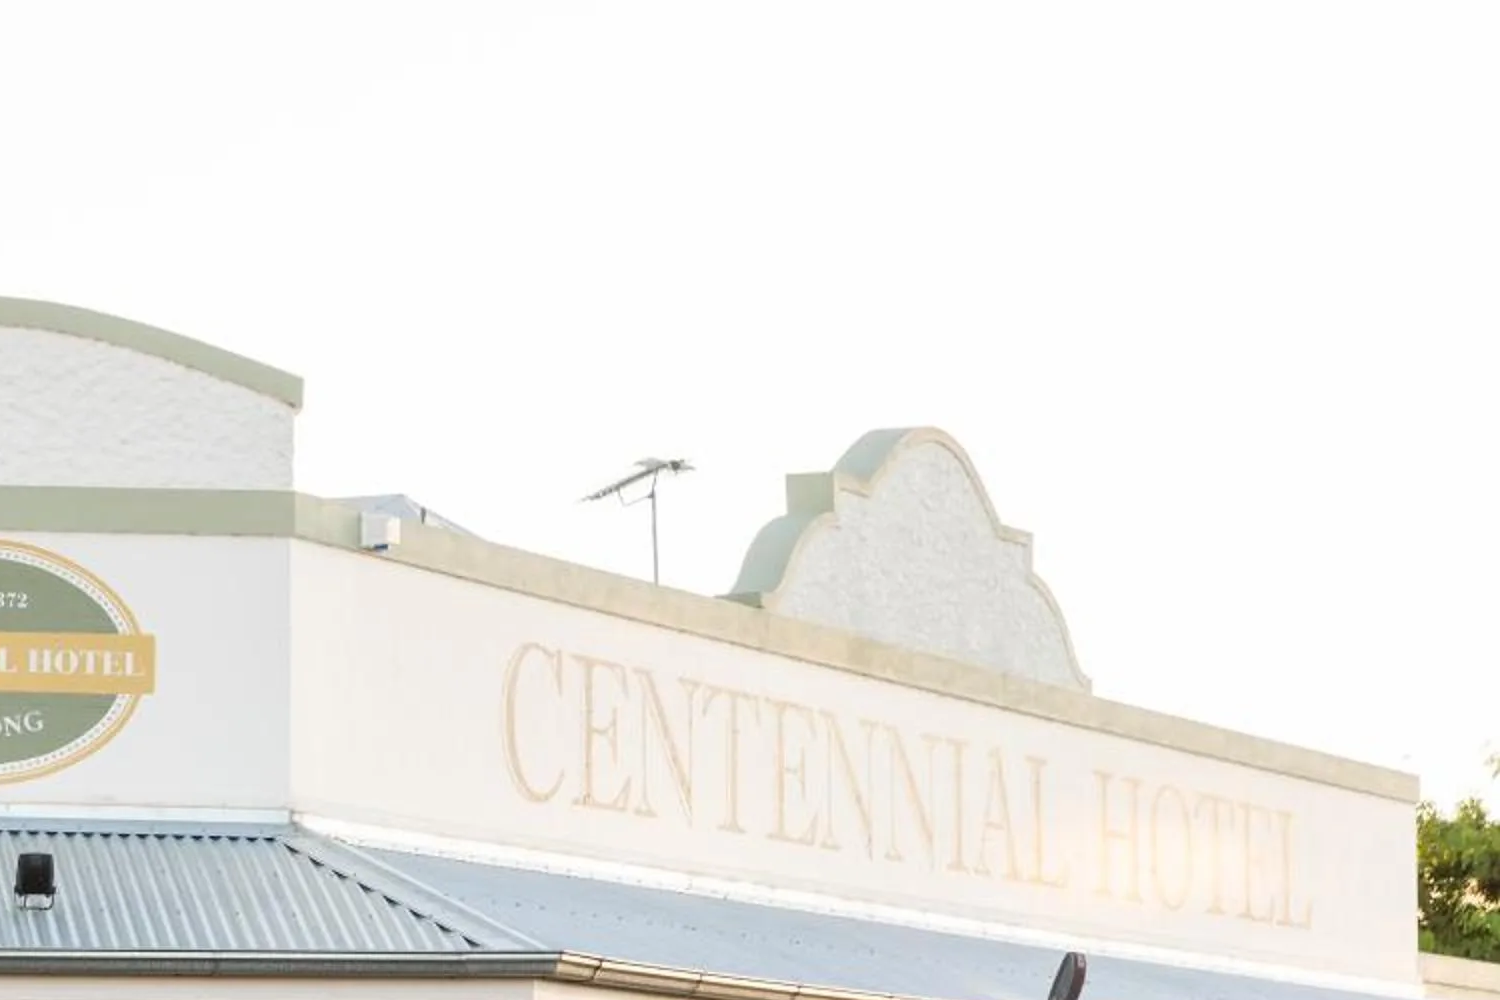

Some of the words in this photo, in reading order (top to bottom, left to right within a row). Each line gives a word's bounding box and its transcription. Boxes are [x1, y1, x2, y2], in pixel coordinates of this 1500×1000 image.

[27, 647, 146, 677] HOTEL
[500, 641, 1071, 892] CENTENNIAL
[1092, 768, 1313, 931] HOTEL
